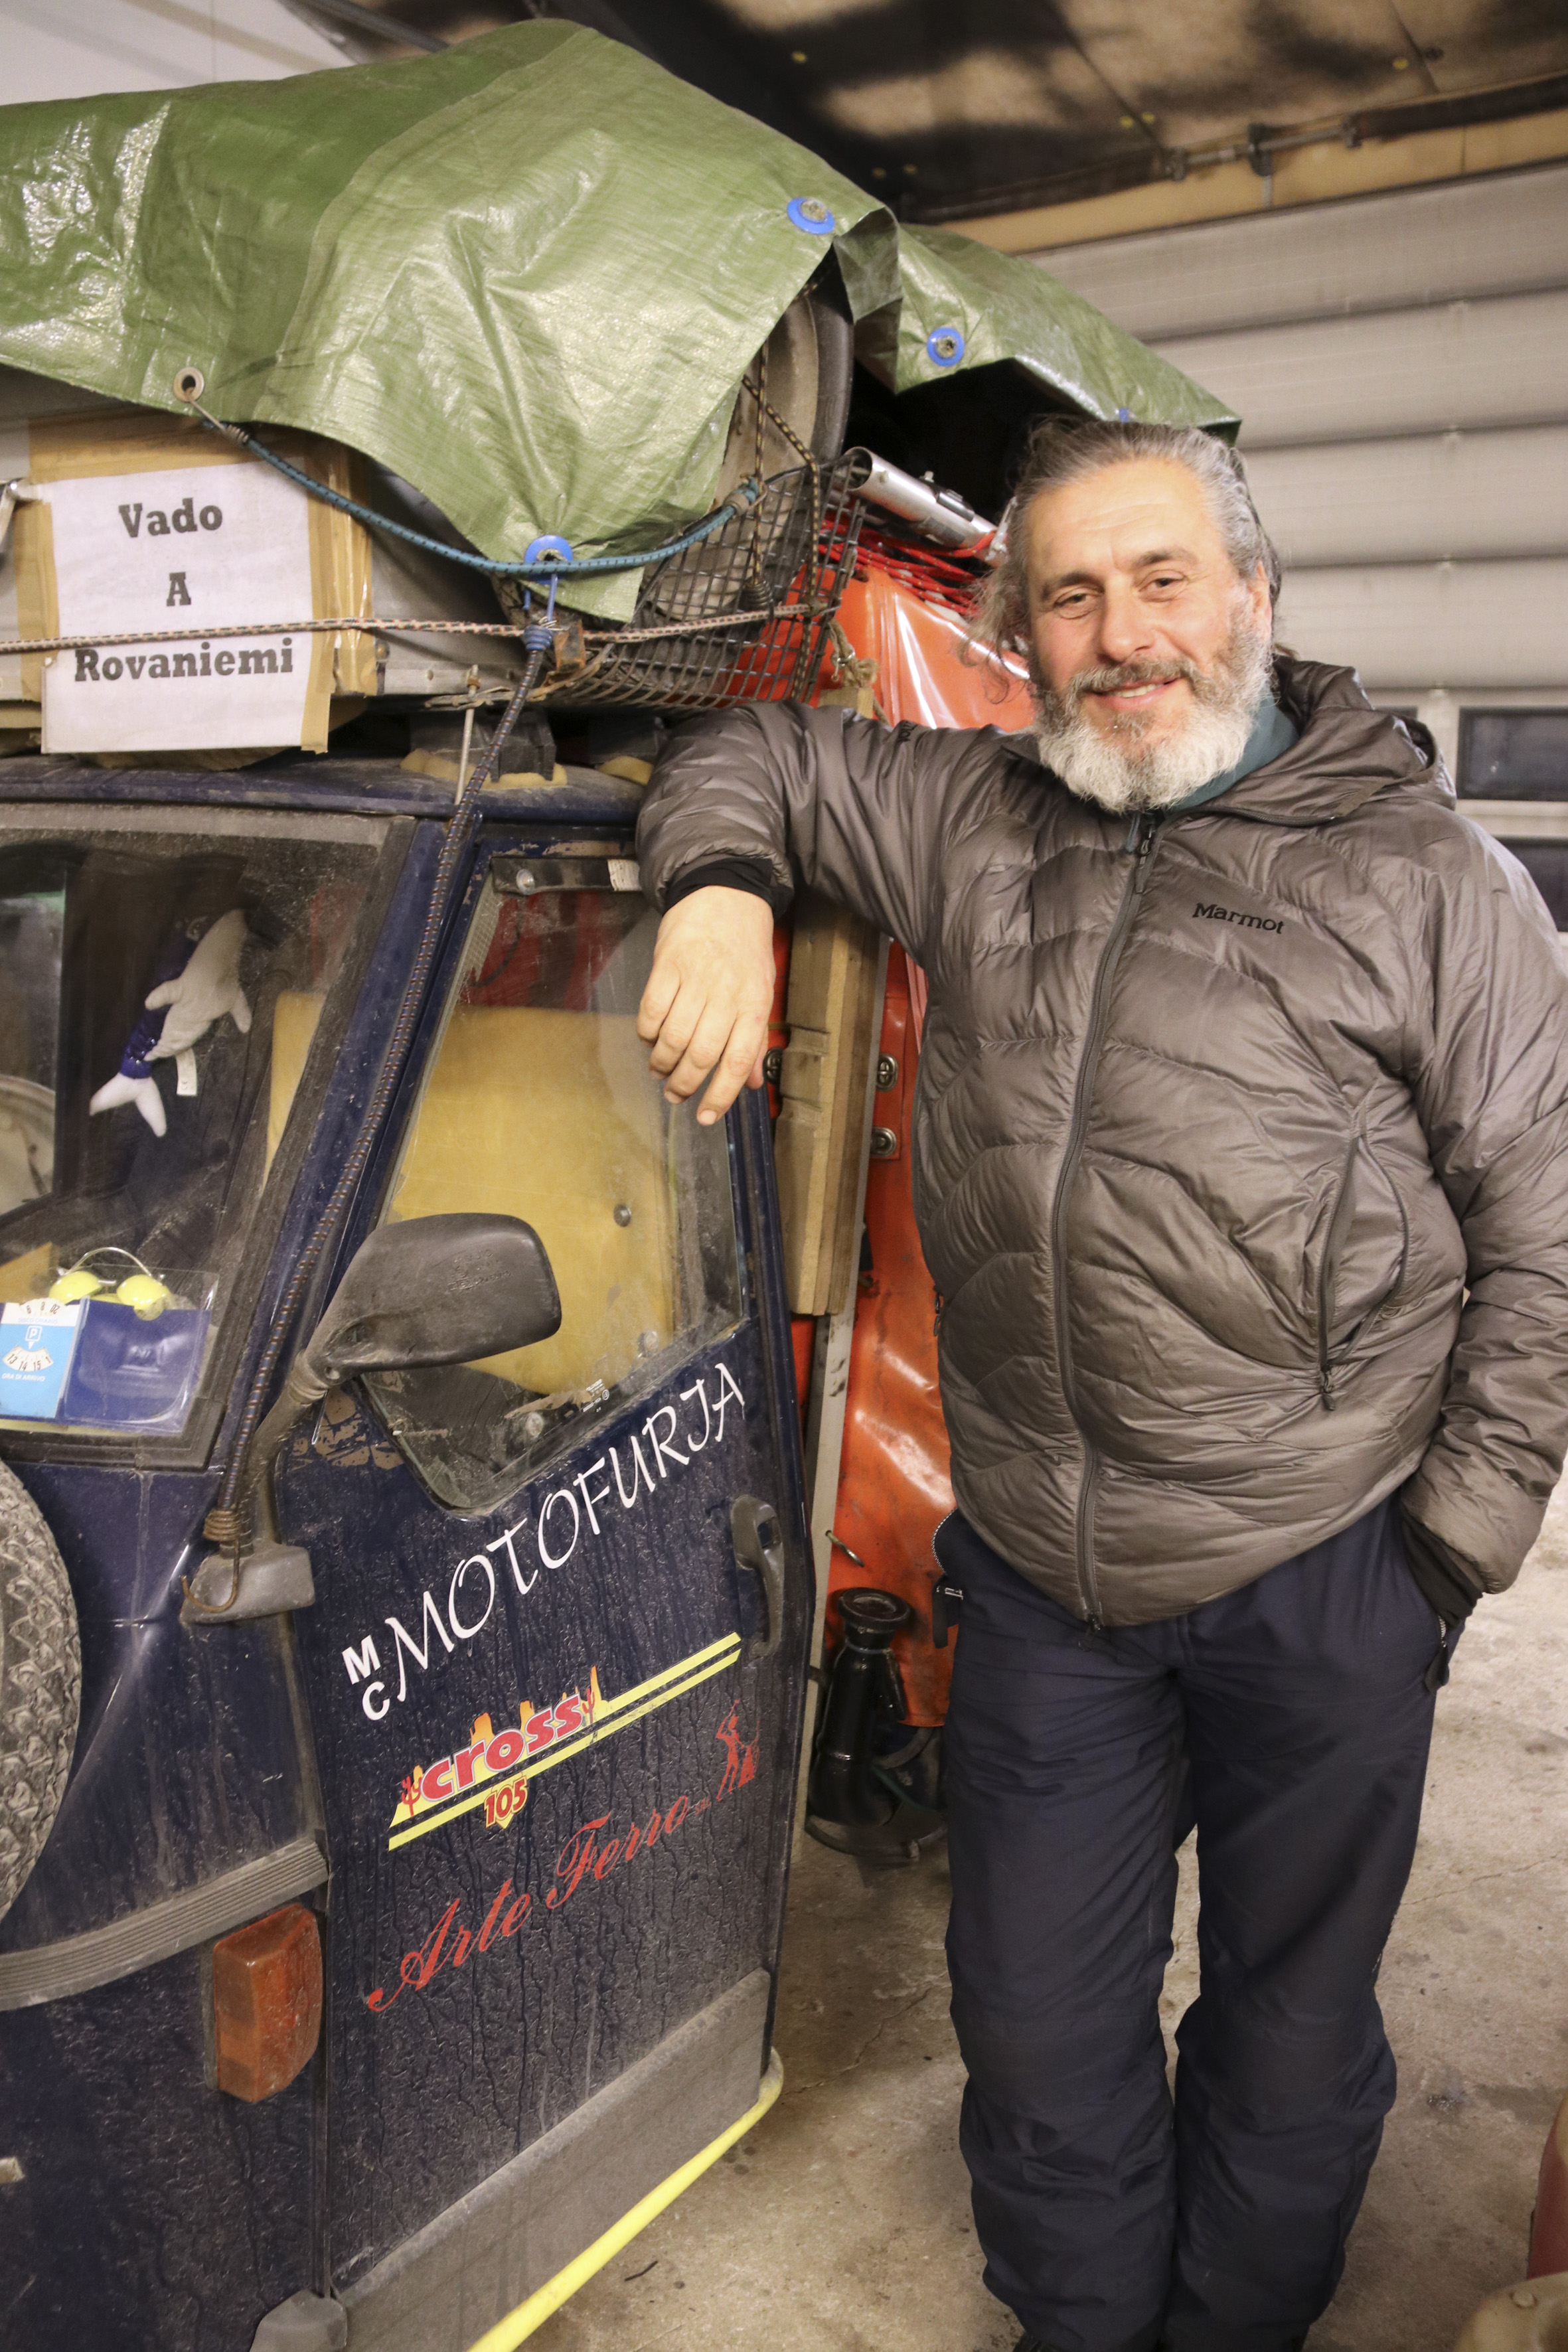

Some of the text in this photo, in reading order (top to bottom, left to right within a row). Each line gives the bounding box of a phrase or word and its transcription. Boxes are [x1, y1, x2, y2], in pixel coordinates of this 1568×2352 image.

[118, 498, 223, 538] Vado
[166, 572, 193, 607] A
[74, 637, 294, 682] Rovaniemi
[1192, 902, 1285, 935] Marmot
[7, 1354, 18, 1364] 13
[19, 1360, 28, 1371] 14
[33, 1360, 41, 1372] 15
[383, 1362, 745, 1702] MOTOFURJA
[420, 1693, 584, 1802] cross
[485, 1777, 528, 1828] 105
[368, 1879, 532, 2011] Arte
[546, 1794, 690, 1910] Ferro
